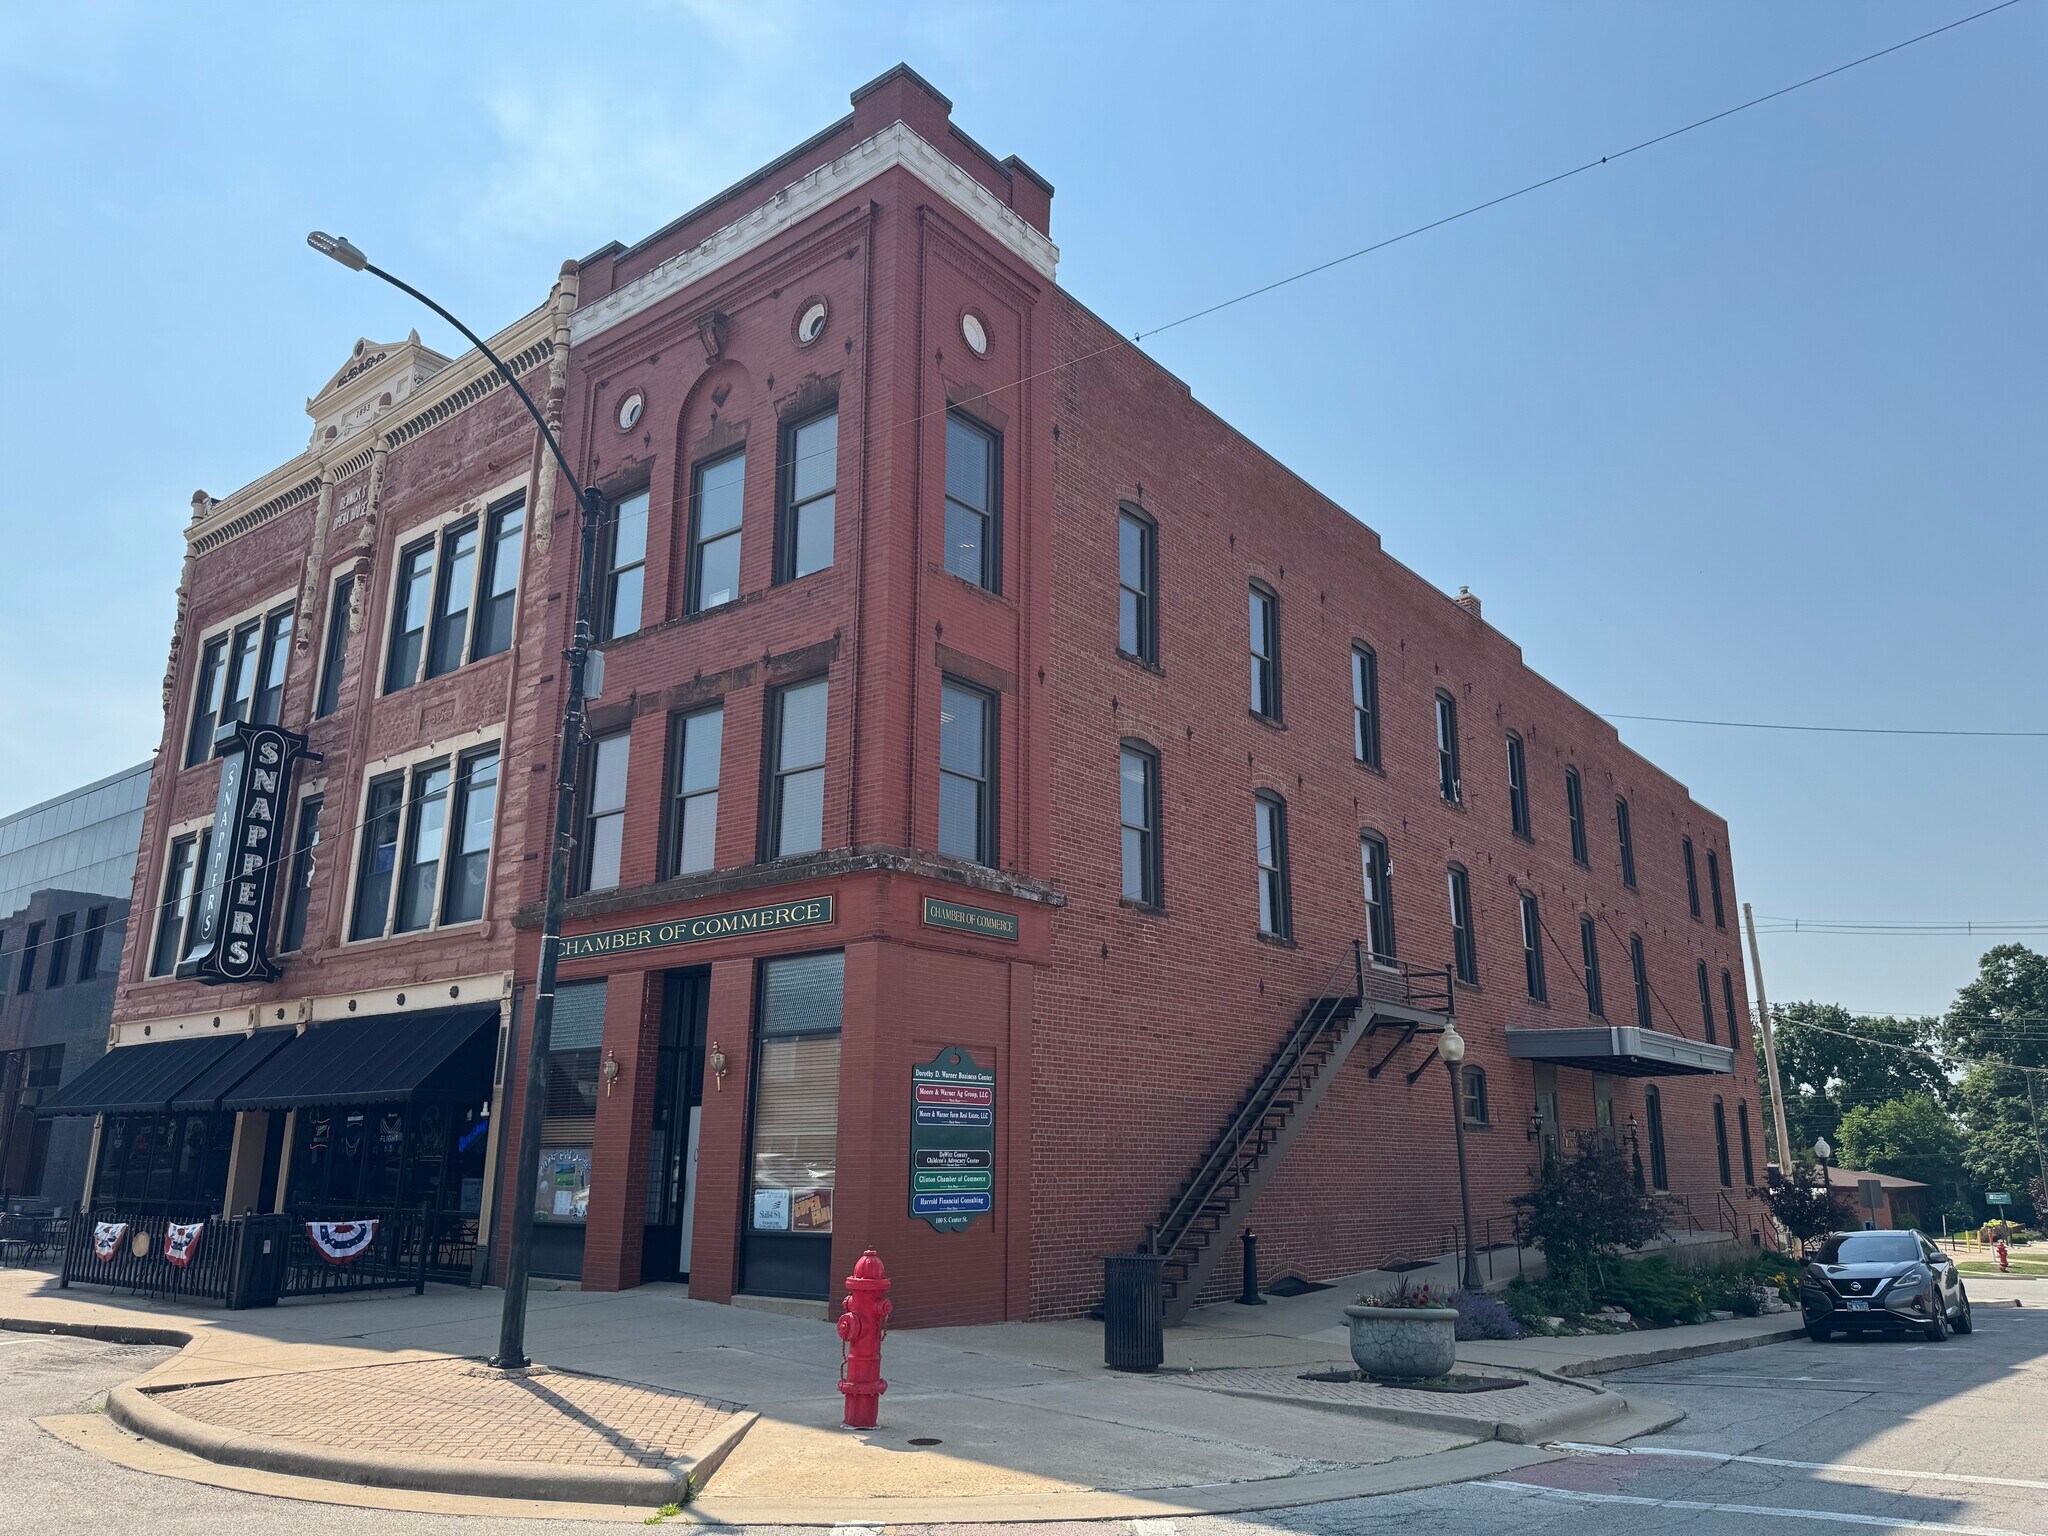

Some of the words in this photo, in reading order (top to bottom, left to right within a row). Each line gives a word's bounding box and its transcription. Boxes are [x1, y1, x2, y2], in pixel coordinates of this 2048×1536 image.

[356, 404, 371, 418] 1893
[204, 769, 234, 932] SNAPPERS
[228, 741, 279, 965] SNAPPERS
[930, 905, 965, 923] CHAMBER
[965, 913, 976, 924] OF
[976, 915, 1014, 932] COMMERCE
[557, 930, 652, 957] CHAMBER
[659, 924, 688, 942] OF
[692, 903, 822, 936] COMMERCE
[916, 1069, 934, 1078] Dorothy
[935, 1070, 941, 1078] D.
[941, 1070, 958, 1079] Warner
[958, 1071, 977, 1080] Business
[977, 1073, 993, 1081] Center
[934, 1088, 940, 1096] &
[940, 1088, 956, 1097] Warner
[957, 1090, 963, 1098] Ag
[919, 1110, 931, 1118] Moore
[380, 1134, 399, 1143] FLIGHT
[918, 1175, 936, 1183] Clinton
[963, 1174, 986, 1182] Commerce
[794, 1195, 821, 1218] SUPER
[920, 1197, 938, 1205] Harrold
[938, 1197, 960, 1205] Financial
[960, 1196, 984, 1205] Consulting
